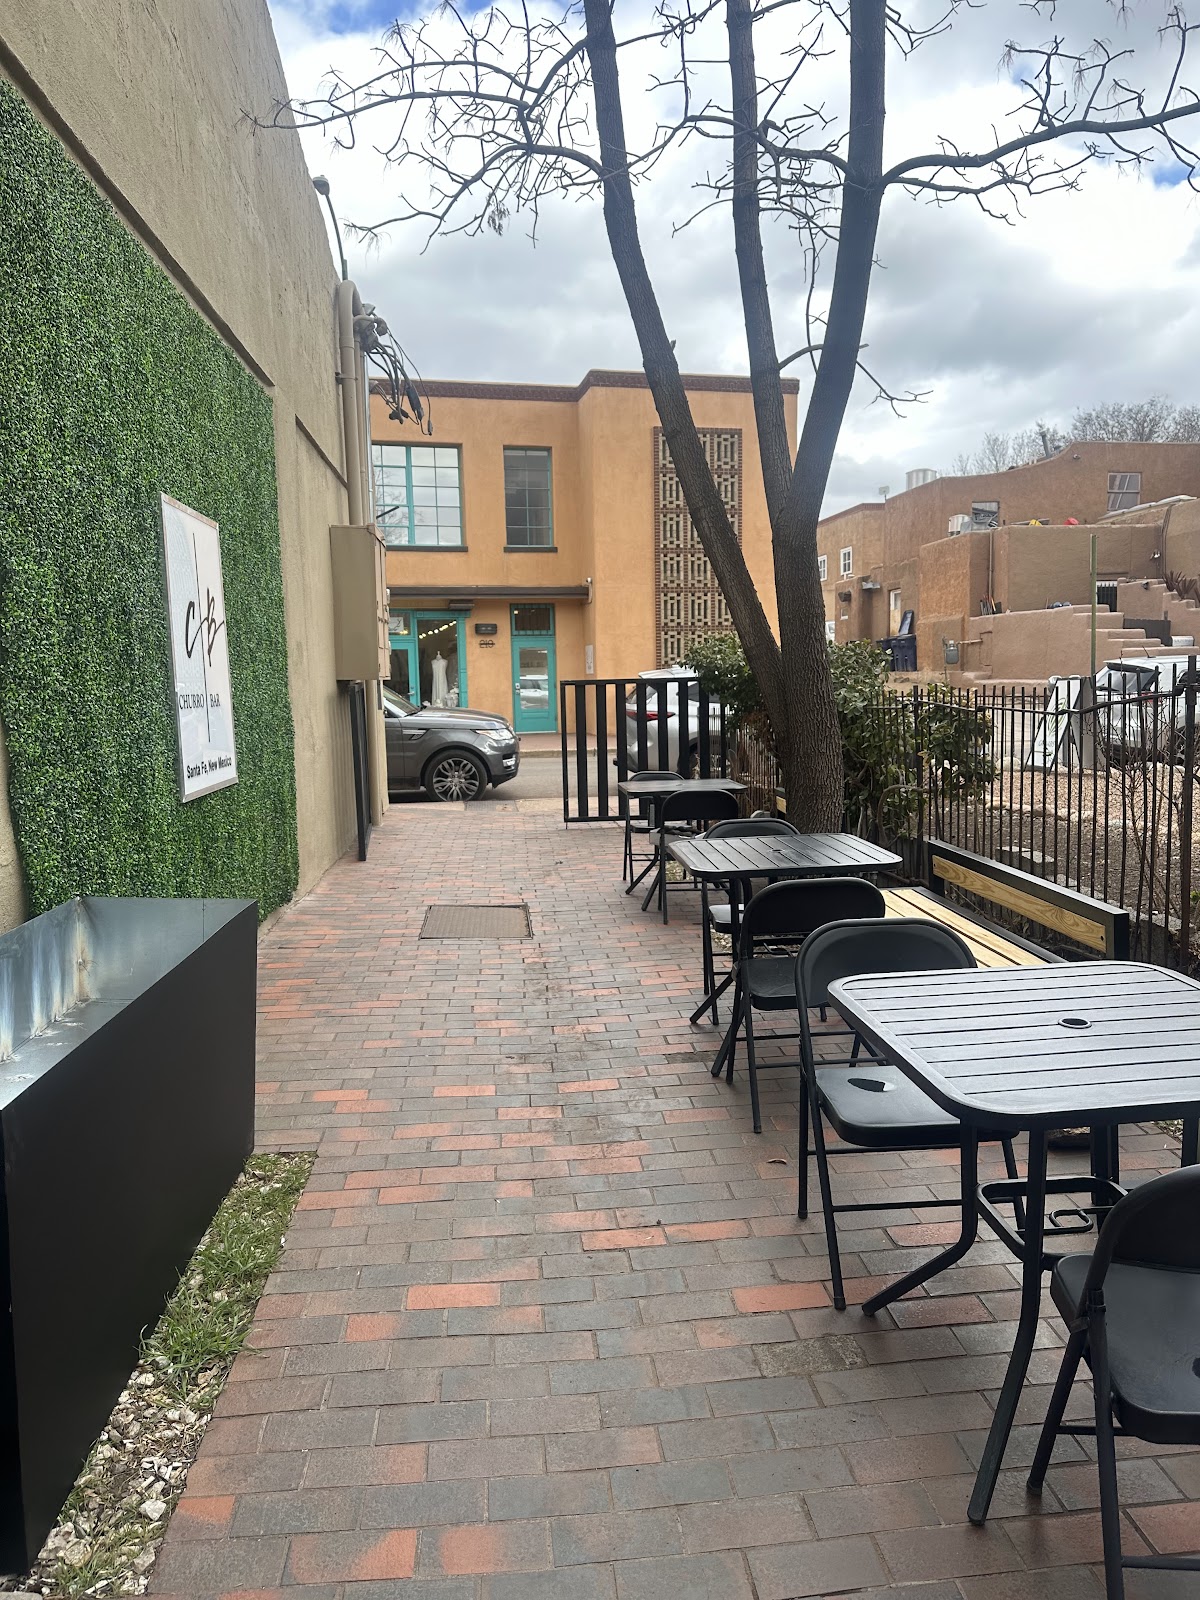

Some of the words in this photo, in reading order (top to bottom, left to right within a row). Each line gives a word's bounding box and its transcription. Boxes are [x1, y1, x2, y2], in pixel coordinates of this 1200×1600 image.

[179, 693, 205, 710] CHURRO
[209, 693, 221, 708] BAR
[186, 763, 201, 779] Santa
[201, 761, 209, 775] Fe,
[208, 759, 218, 772] New
[217, 755, 232, 769] Mexico
